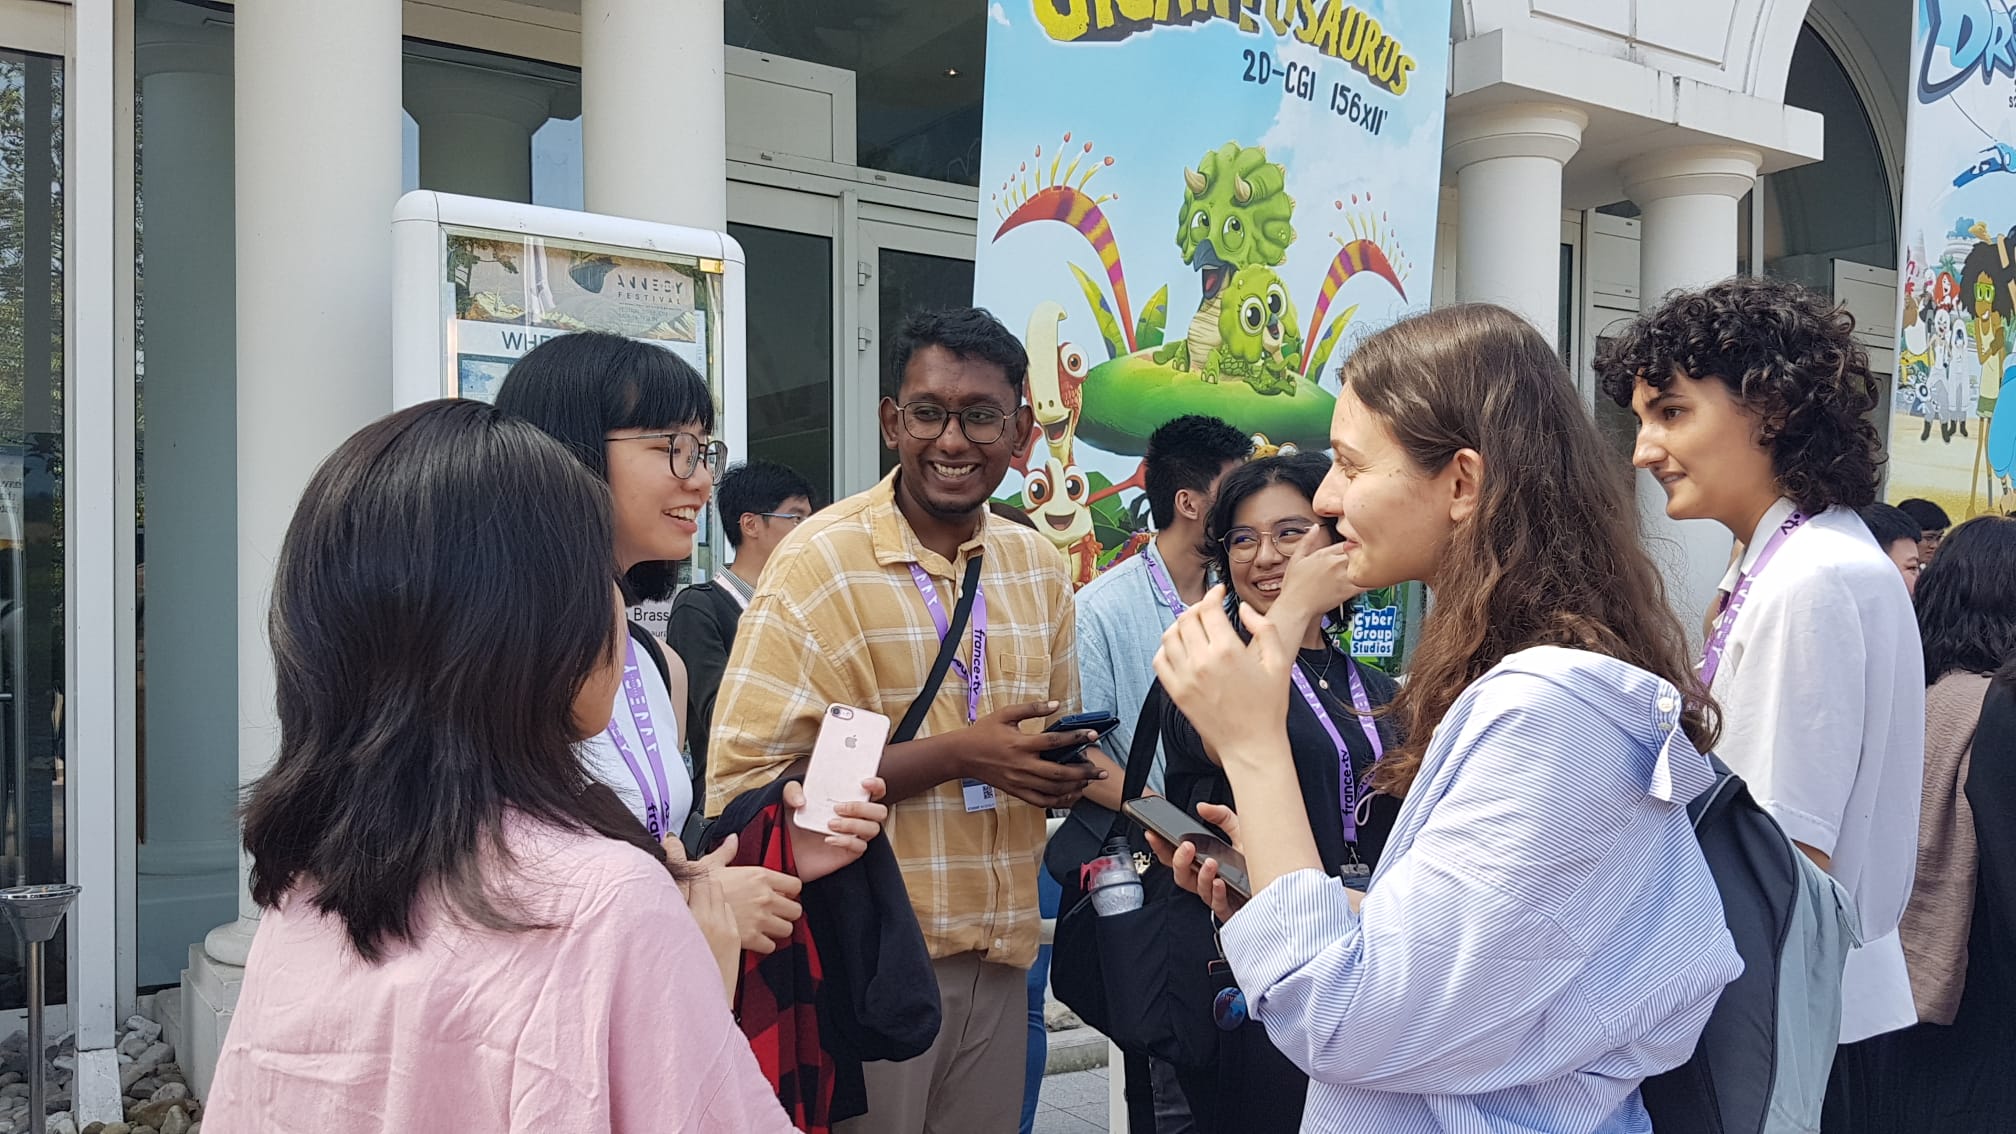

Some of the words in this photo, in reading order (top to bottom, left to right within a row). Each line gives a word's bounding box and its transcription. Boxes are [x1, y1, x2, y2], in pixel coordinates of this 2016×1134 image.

[1242, 49, 1316, 101] 2D-CGI
[618, 291, 681, 305] FESTIVAL
[1354, 612, 1393, 628] Cyber
[1353, 626, 1392, 642] Group
[1352, 642, 1391, 653] Studios
